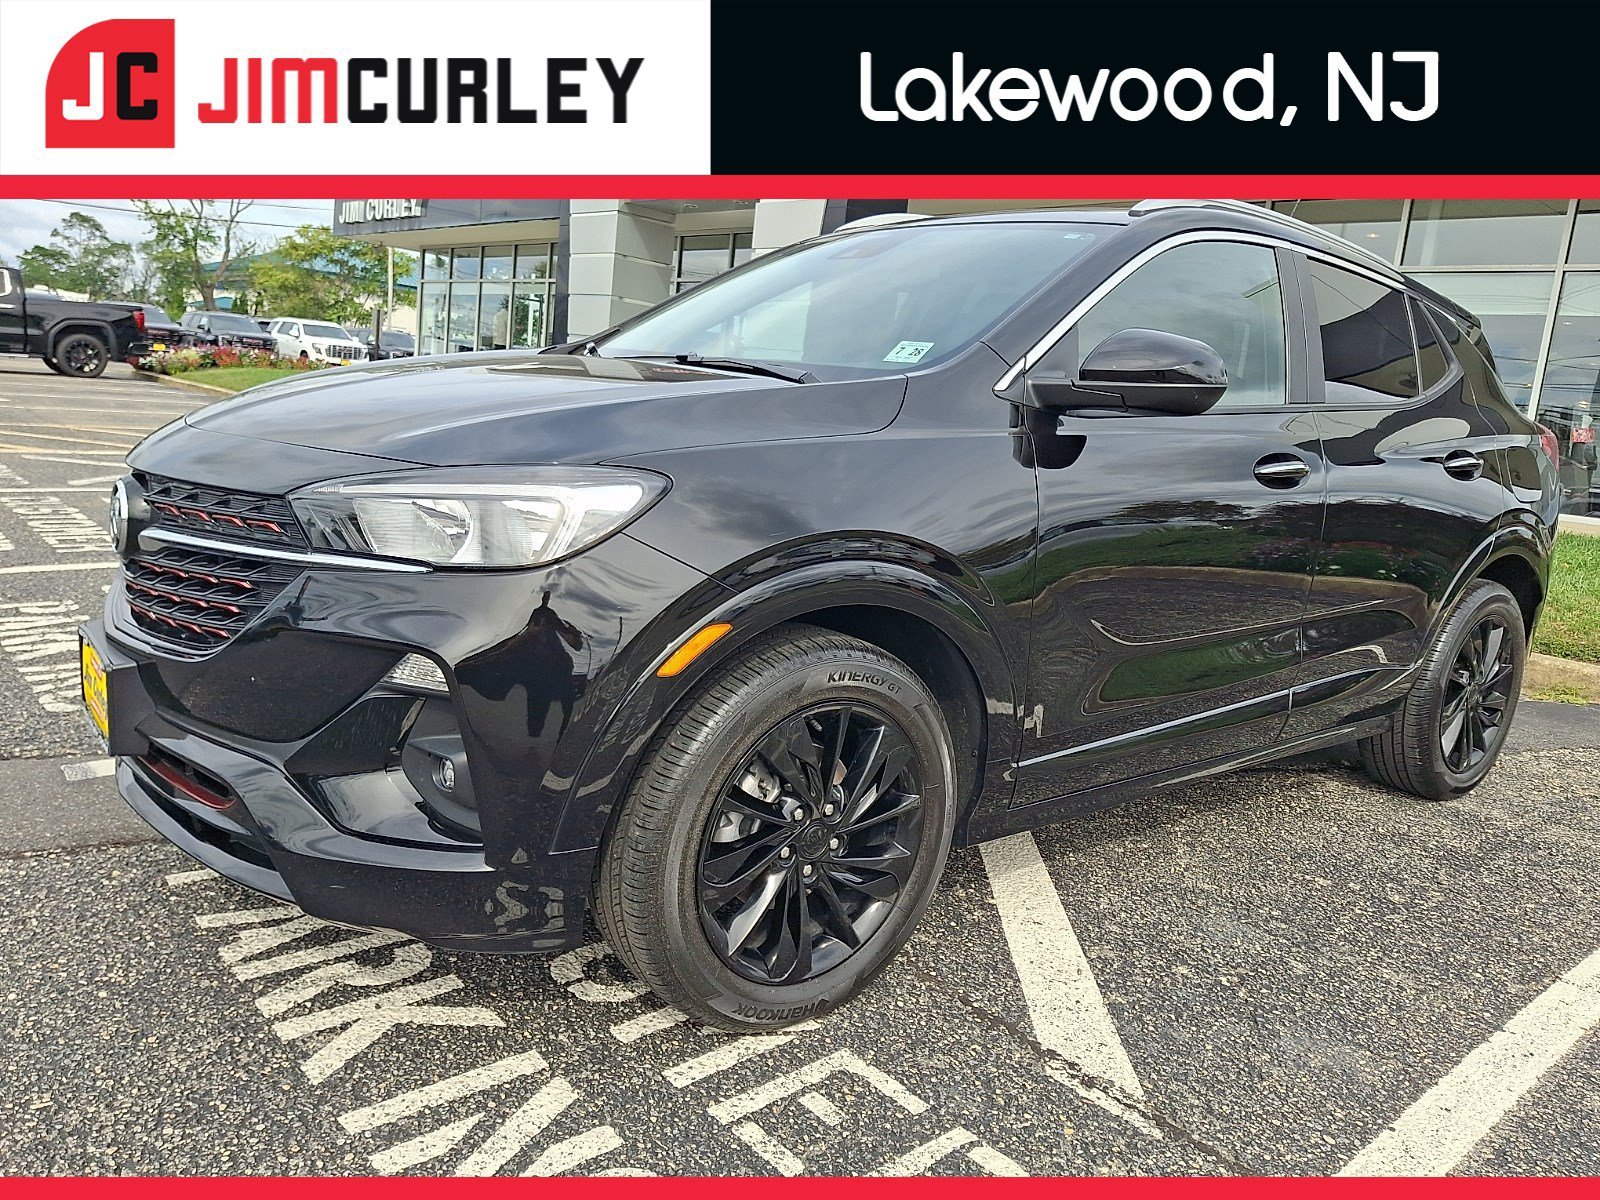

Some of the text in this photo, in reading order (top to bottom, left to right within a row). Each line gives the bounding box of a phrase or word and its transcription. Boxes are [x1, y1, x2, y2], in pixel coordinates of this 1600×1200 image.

[338, 201, 365, 224] JIM
[896, 346, 906, 355] 7
[827, 670, 902, 695] KINERGY GT
